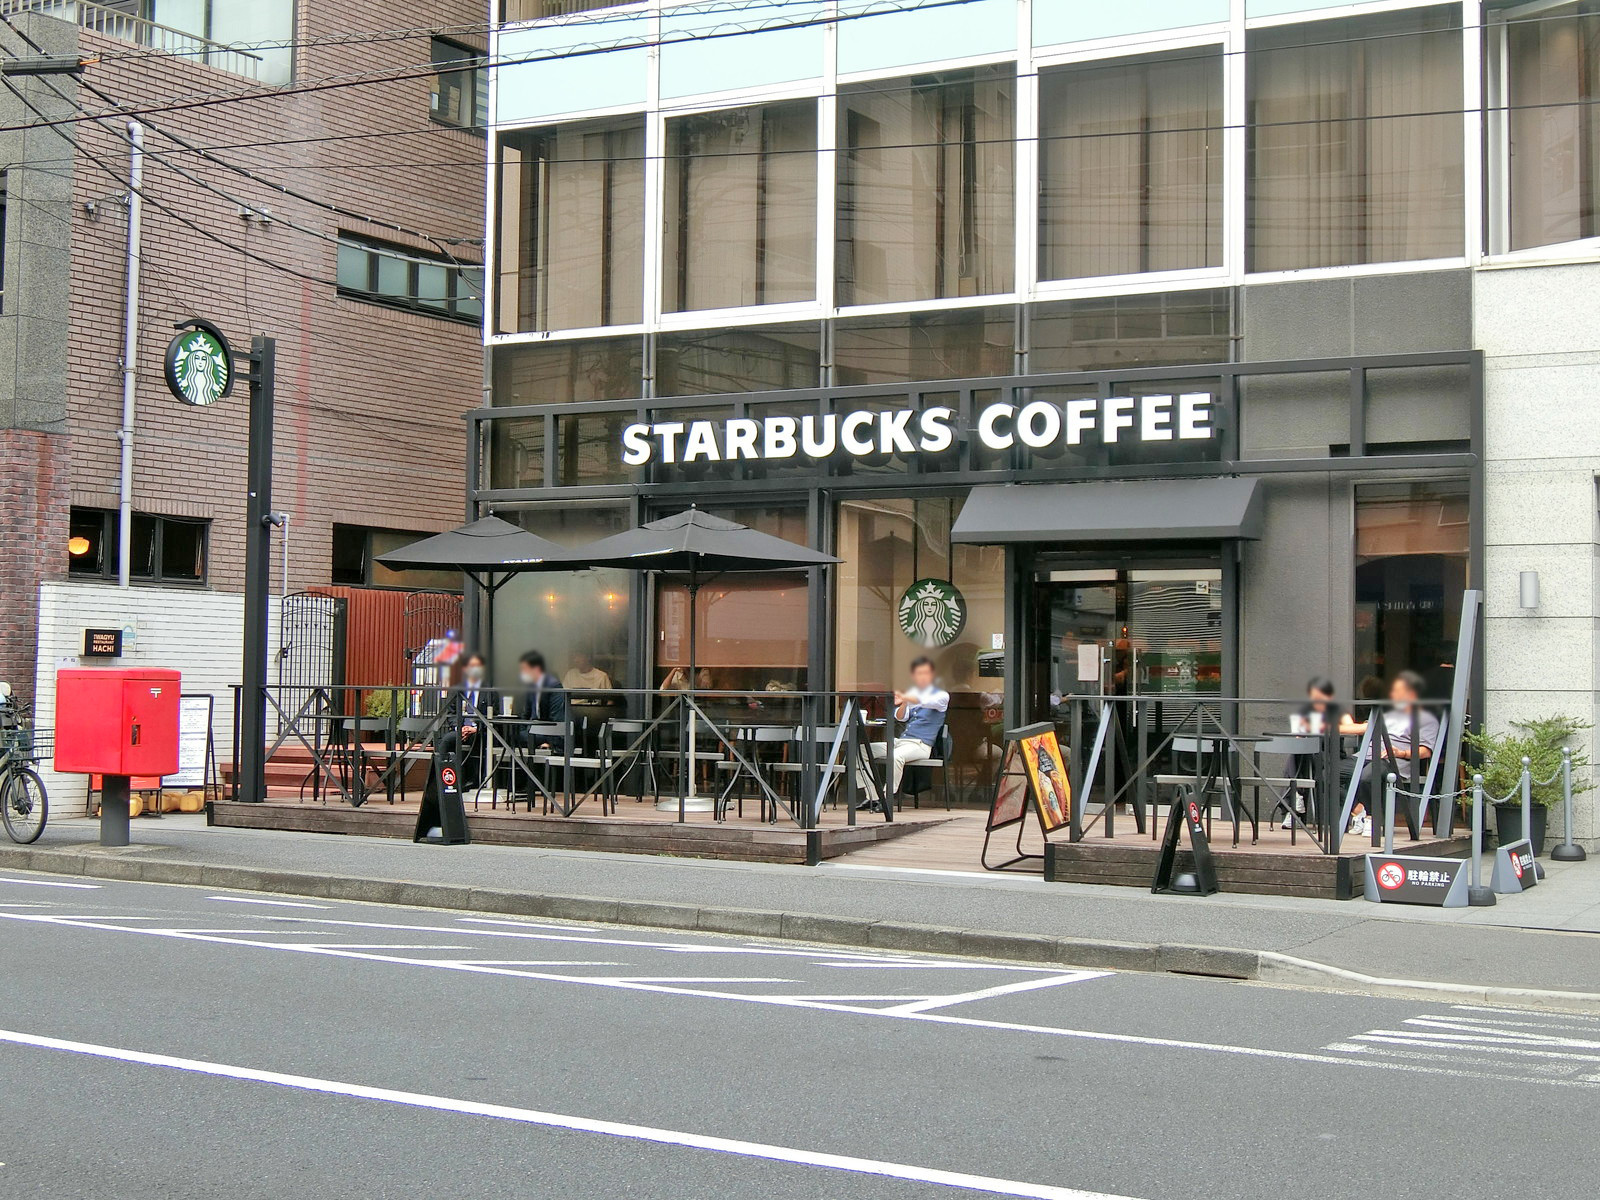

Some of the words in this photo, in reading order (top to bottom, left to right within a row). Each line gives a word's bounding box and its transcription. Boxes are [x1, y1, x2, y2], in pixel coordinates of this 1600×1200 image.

[622, 407, 954, 466] STARBUCKS
[978, 392, 1212, 450] COFFEE
[1407, 870, 1450, 882] 駐輪禁止
